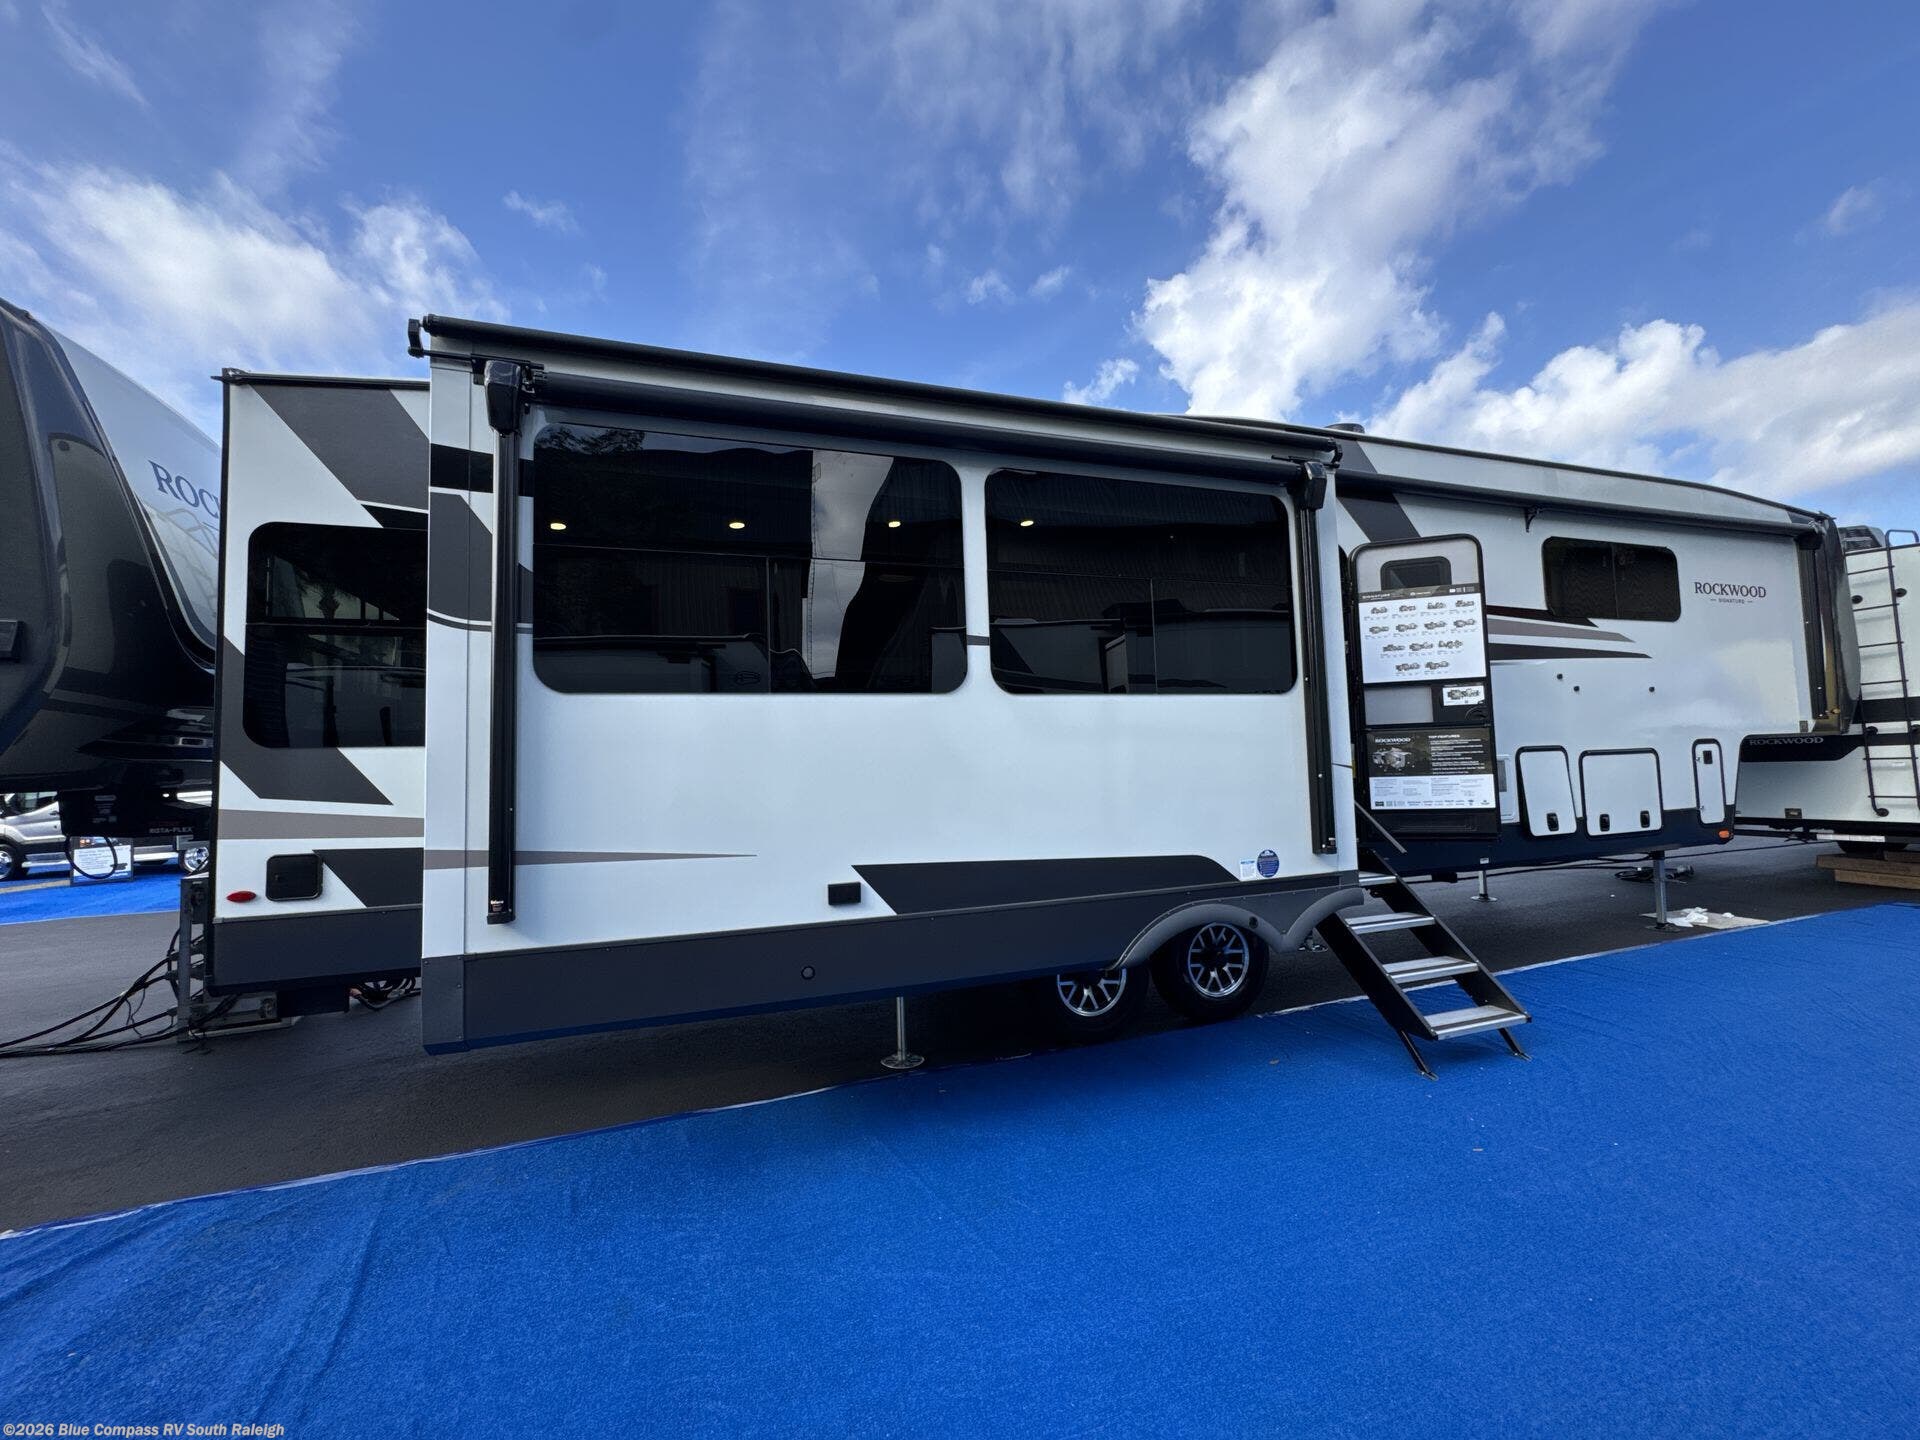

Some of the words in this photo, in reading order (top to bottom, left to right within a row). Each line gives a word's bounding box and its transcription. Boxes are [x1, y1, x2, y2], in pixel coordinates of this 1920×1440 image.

[147, 459, 220, 519] ROC
[1694, 581, 1767, 598] ROCKWOOD
[1749, 736, 1824, 746] ROCKWOOD
